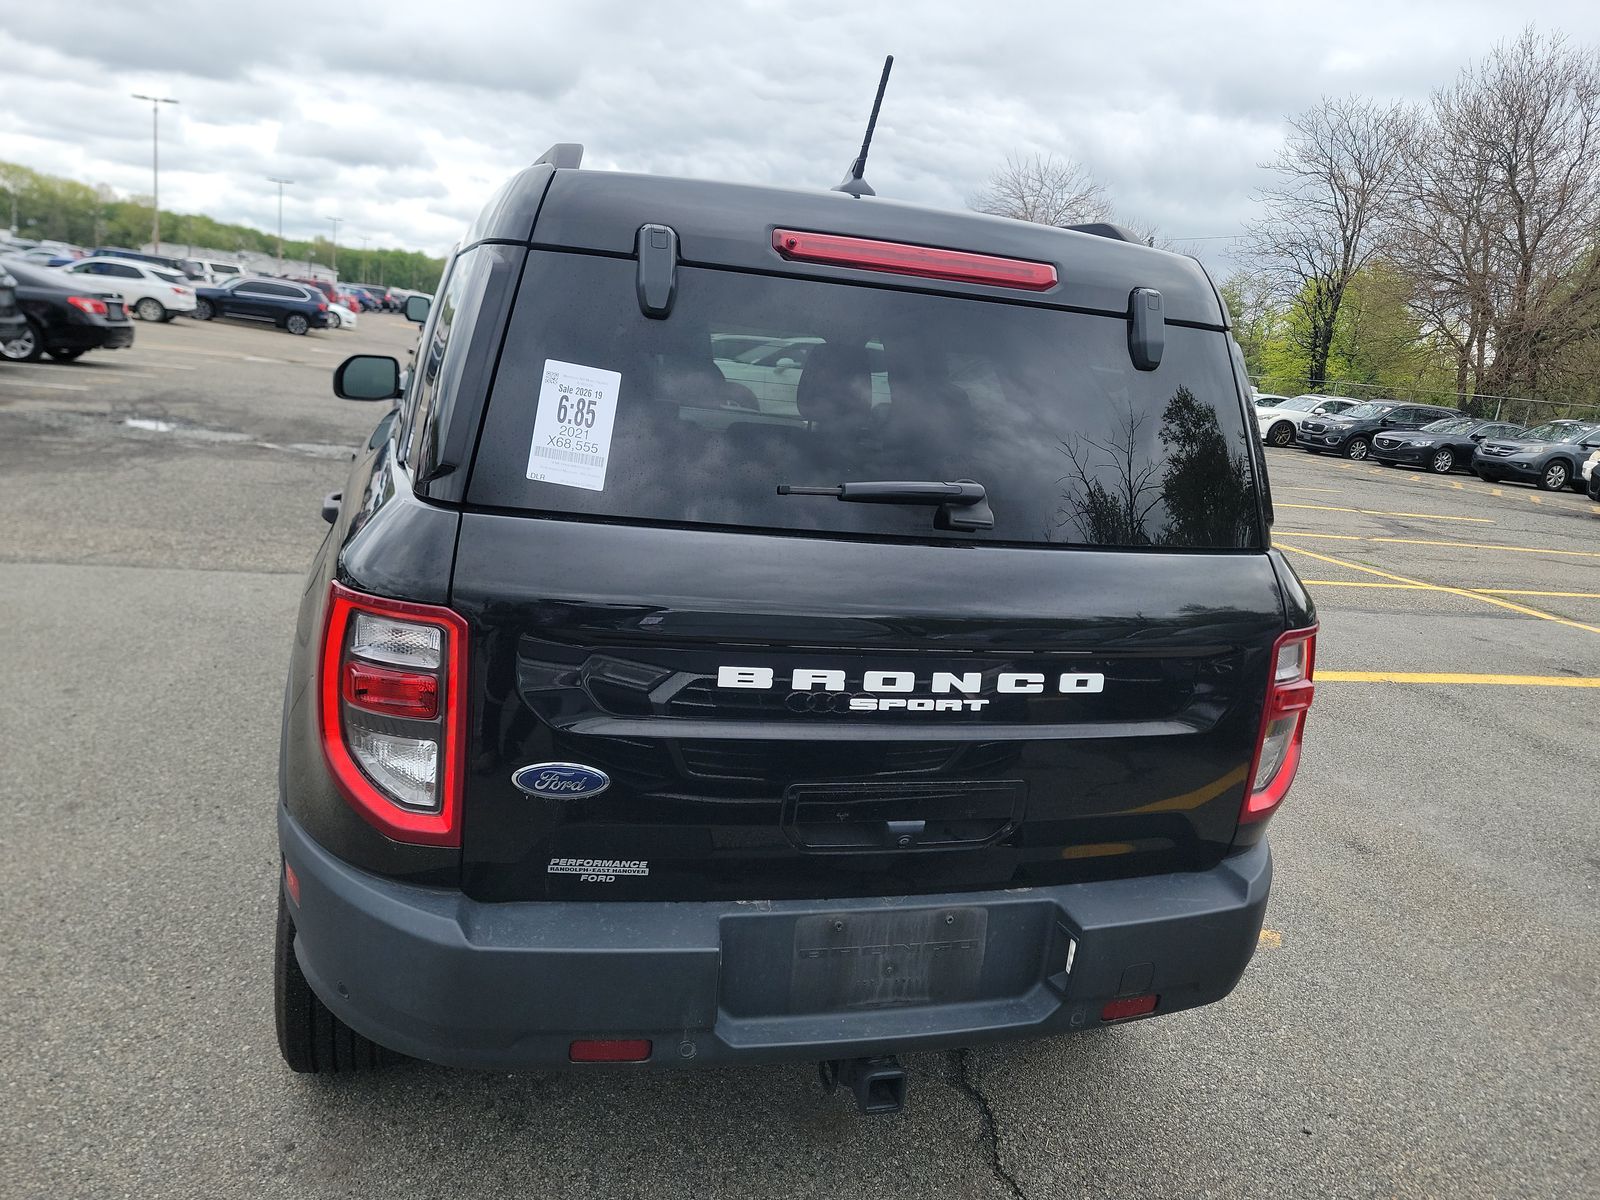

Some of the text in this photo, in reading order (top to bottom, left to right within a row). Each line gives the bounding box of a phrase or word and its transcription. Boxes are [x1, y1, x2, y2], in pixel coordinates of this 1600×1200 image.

[558, 384, 603, 400] Sale 2026 19
[559, 426, 589, 440] 2021
[547, 435, 599, 454] X68,555
[716, 665, 1105, 694] BRONCO
[849, 698, 990, 712] SPORT
[534, 770, 588, 791] Ford
[550, 858, 648, 868] PERFORMANCE
[580, 874, 616, 883] FORD
